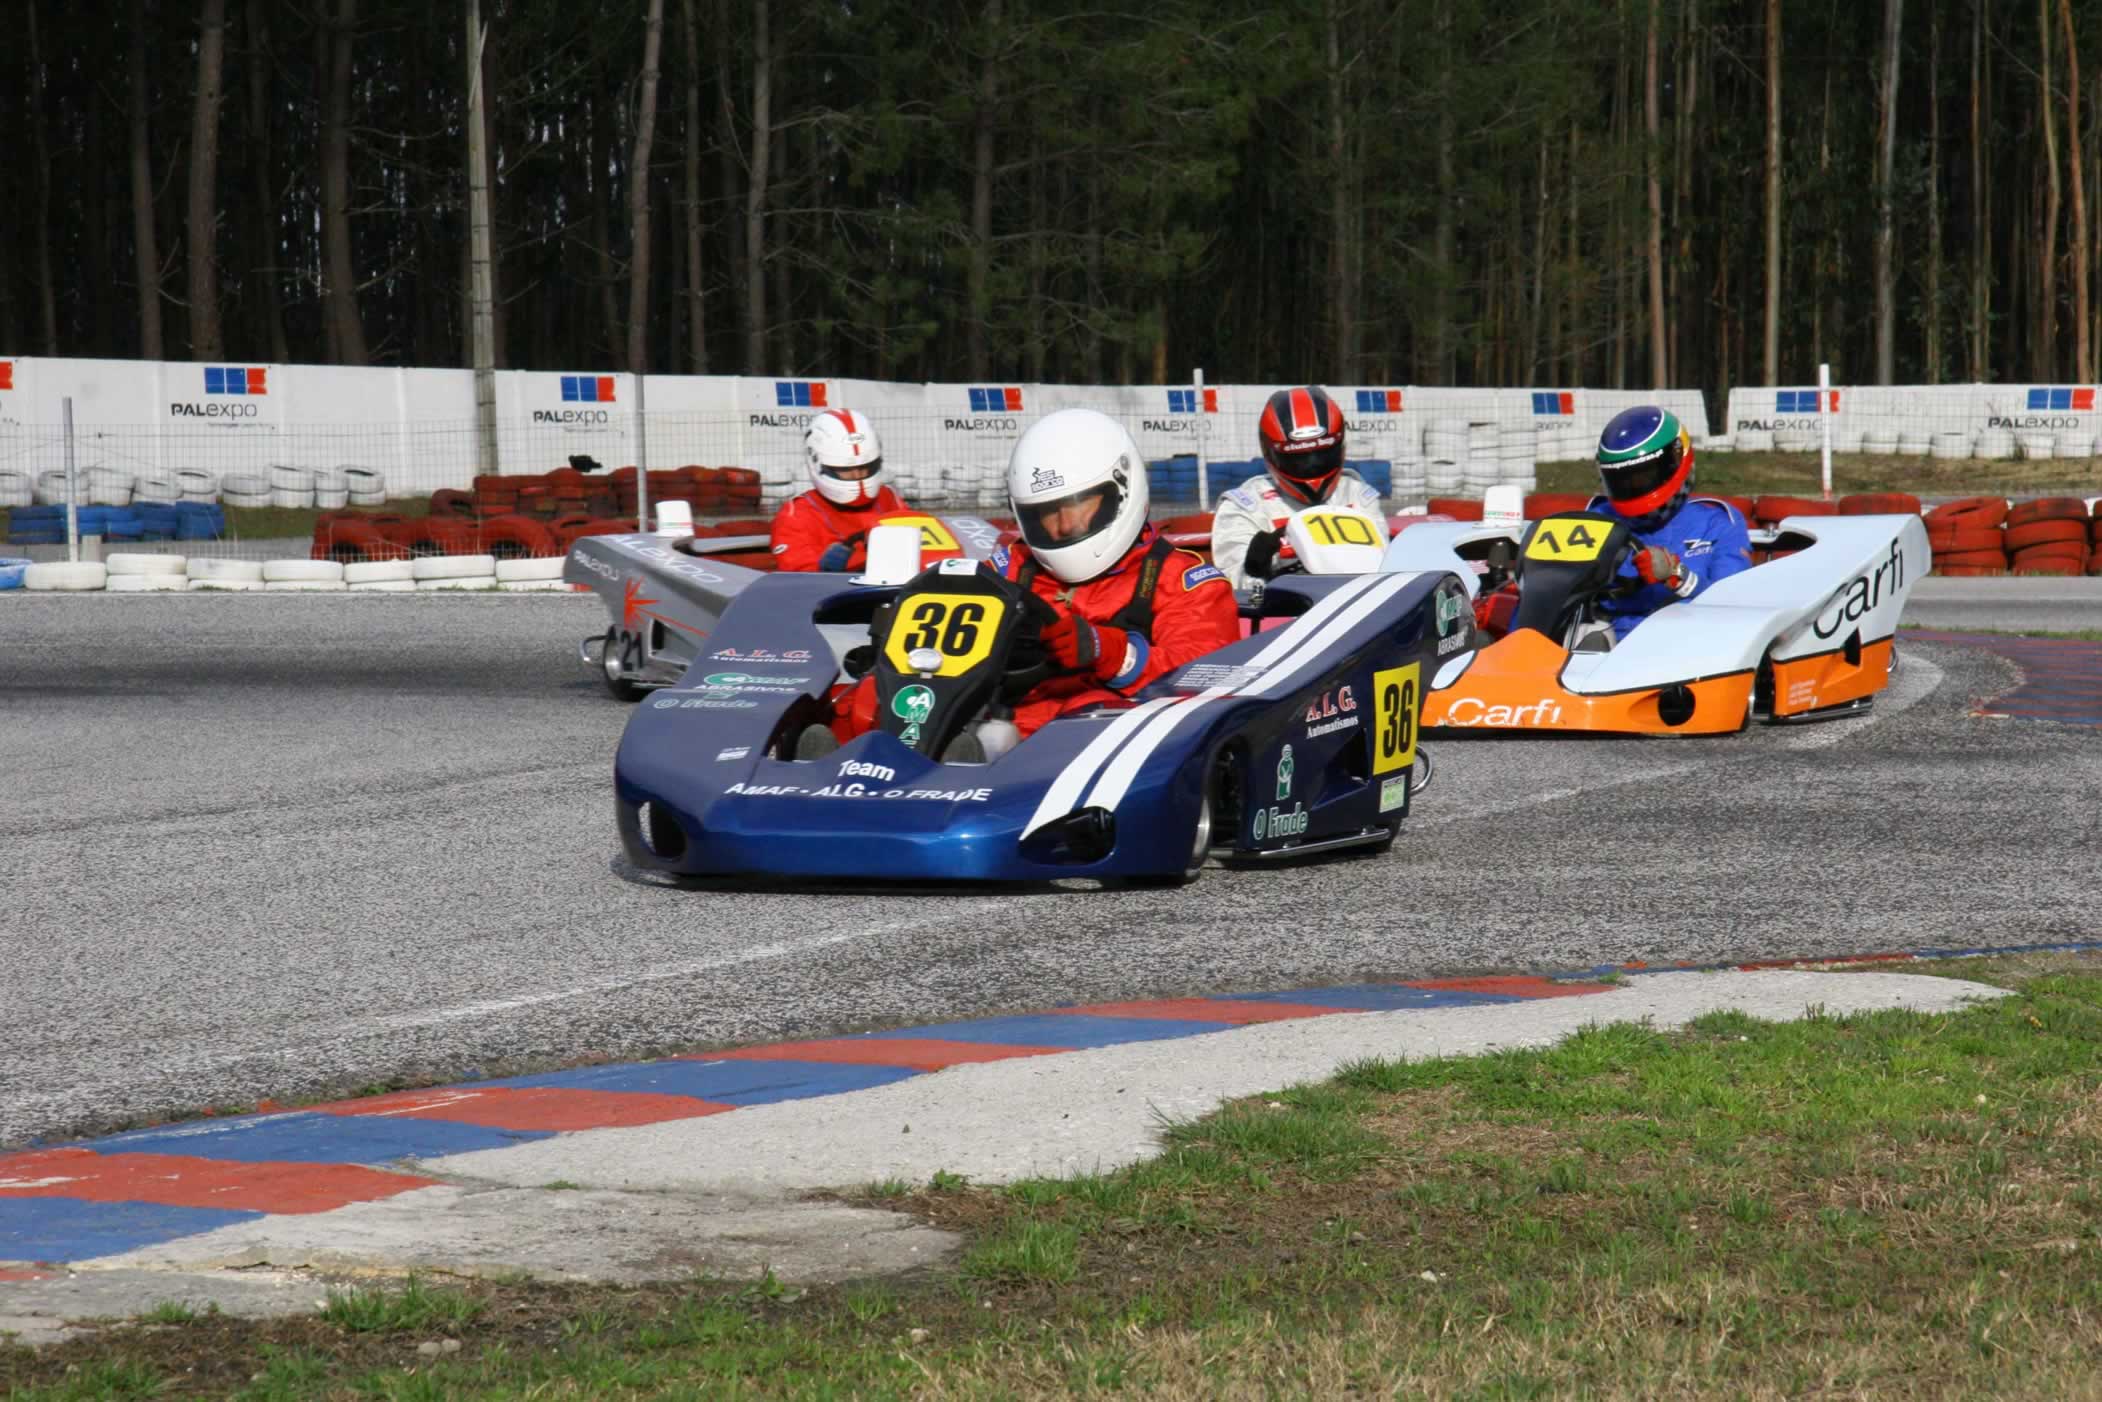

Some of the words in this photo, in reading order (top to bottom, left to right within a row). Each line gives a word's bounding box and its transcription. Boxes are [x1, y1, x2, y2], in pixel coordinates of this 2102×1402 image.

[171, 403, 258, 421] PALexpo
[533, 409, 608, 427] PALexpo
[944, 417, 1017, 432] PALexpo
[1987, 416, 2080, 431] PALexpo
[1308, 515, 1375, 546] 10
[1537, 524, 1597, 553] 14
[1812, 536, 1904, 640] Carfi
[903, 602, 985, 657] 36
[620, 629, 643, 671] 21
[1382, 678, 1415, 759] 36
[1448, 697, 1562, 727] Carfi
[1306, 715, 1359, 740] Automatismos
[837, 759, 896, 781] Team
[723, 783, 800, 796] AMAF
[809, 783, 866, 798] ALG
[904, 788, 993, 801] FRADE
[1253, 808, 1267, 841] O
[1267, 801, 1309, 839] Frade
